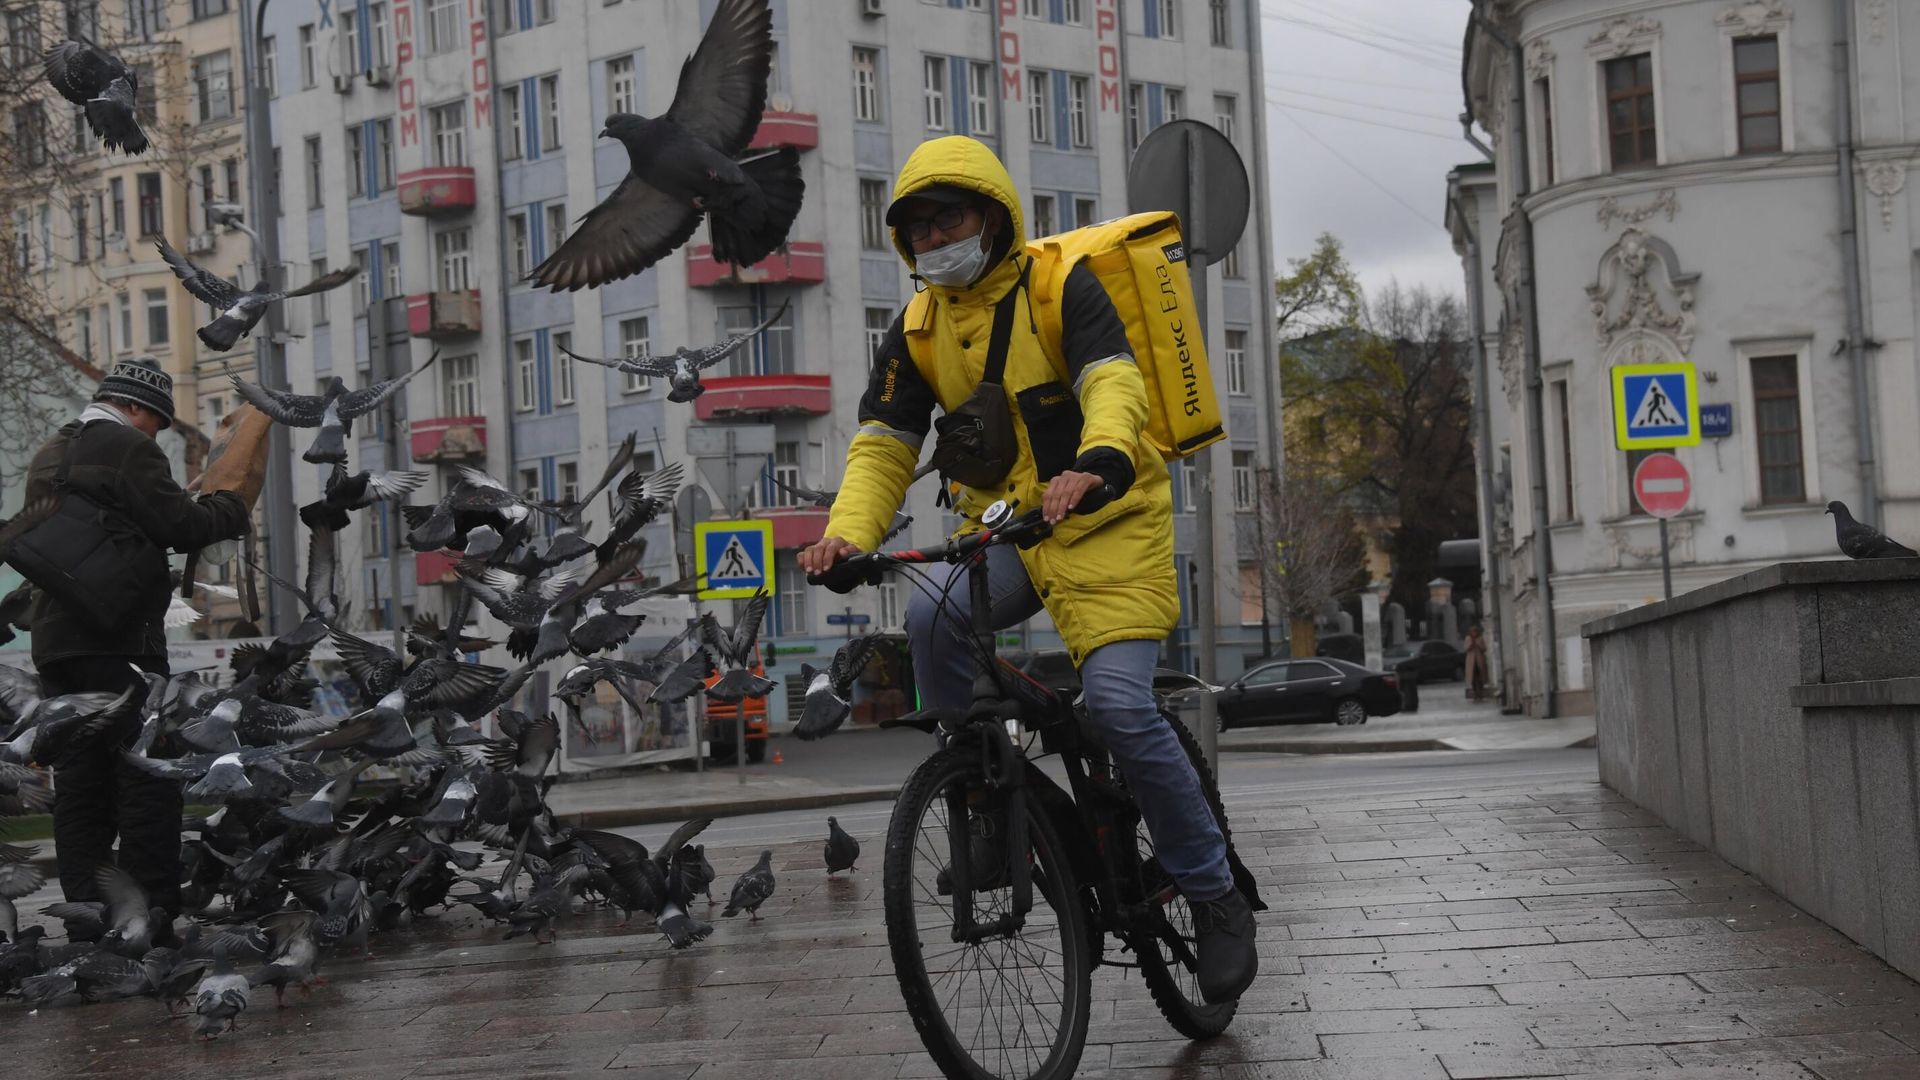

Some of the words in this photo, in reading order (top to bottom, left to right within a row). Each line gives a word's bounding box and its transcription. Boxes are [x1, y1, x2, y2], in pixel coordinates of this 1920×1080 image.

[393, 0, 418, 147] ПРОМ
[1096, 0, 1119, 113] РОМ
[1155, 264, 1179, 313] Еда
[1169, 319, 1202, 417] Яндекс
